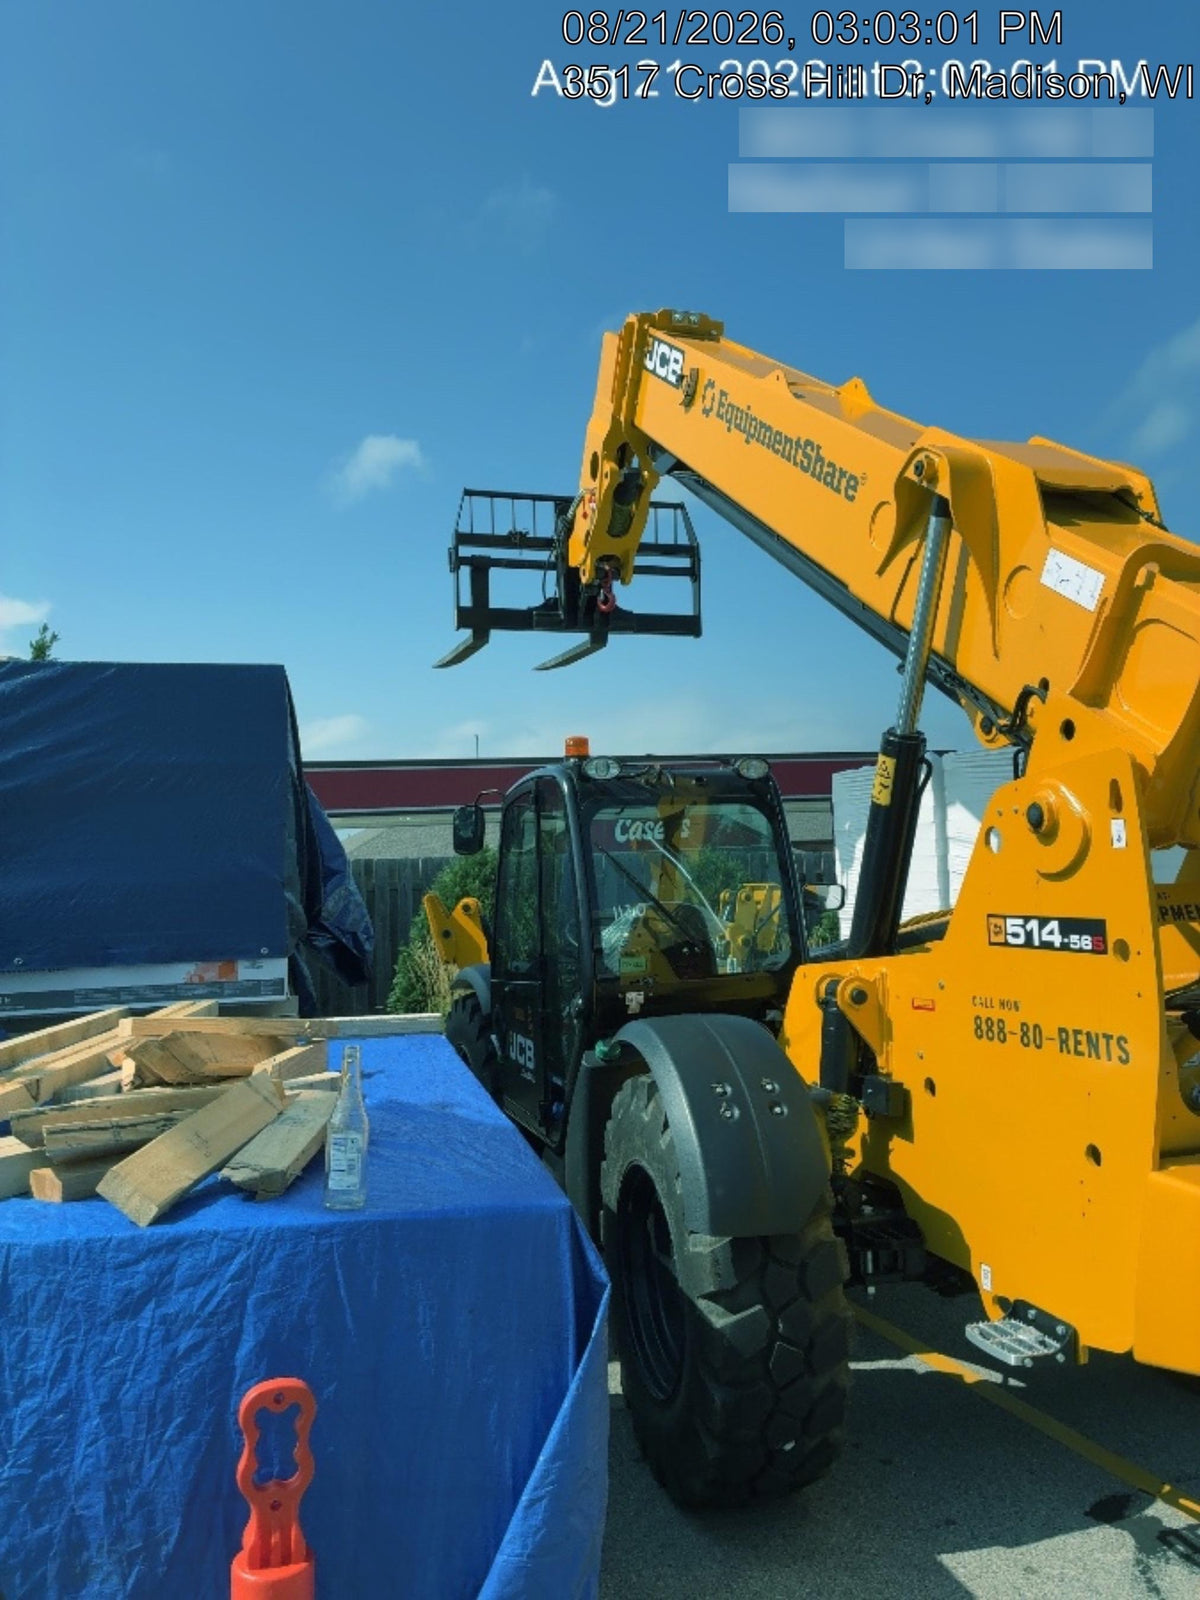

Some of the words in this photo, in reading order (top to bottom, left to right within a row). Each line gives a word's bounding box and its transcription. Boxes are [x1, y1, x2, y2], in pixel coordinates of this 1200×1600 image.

[644, 340, 684, 385] JCB
[716, 389, 860, 502] EquipmentShare
[1156, 904, 1200, 922] PME
[972, 995, 995, 1009] CALL
[510, 1032, 535, 1070] JCB
[974, 1015, 1130, 1065] 888-80-RENTS
